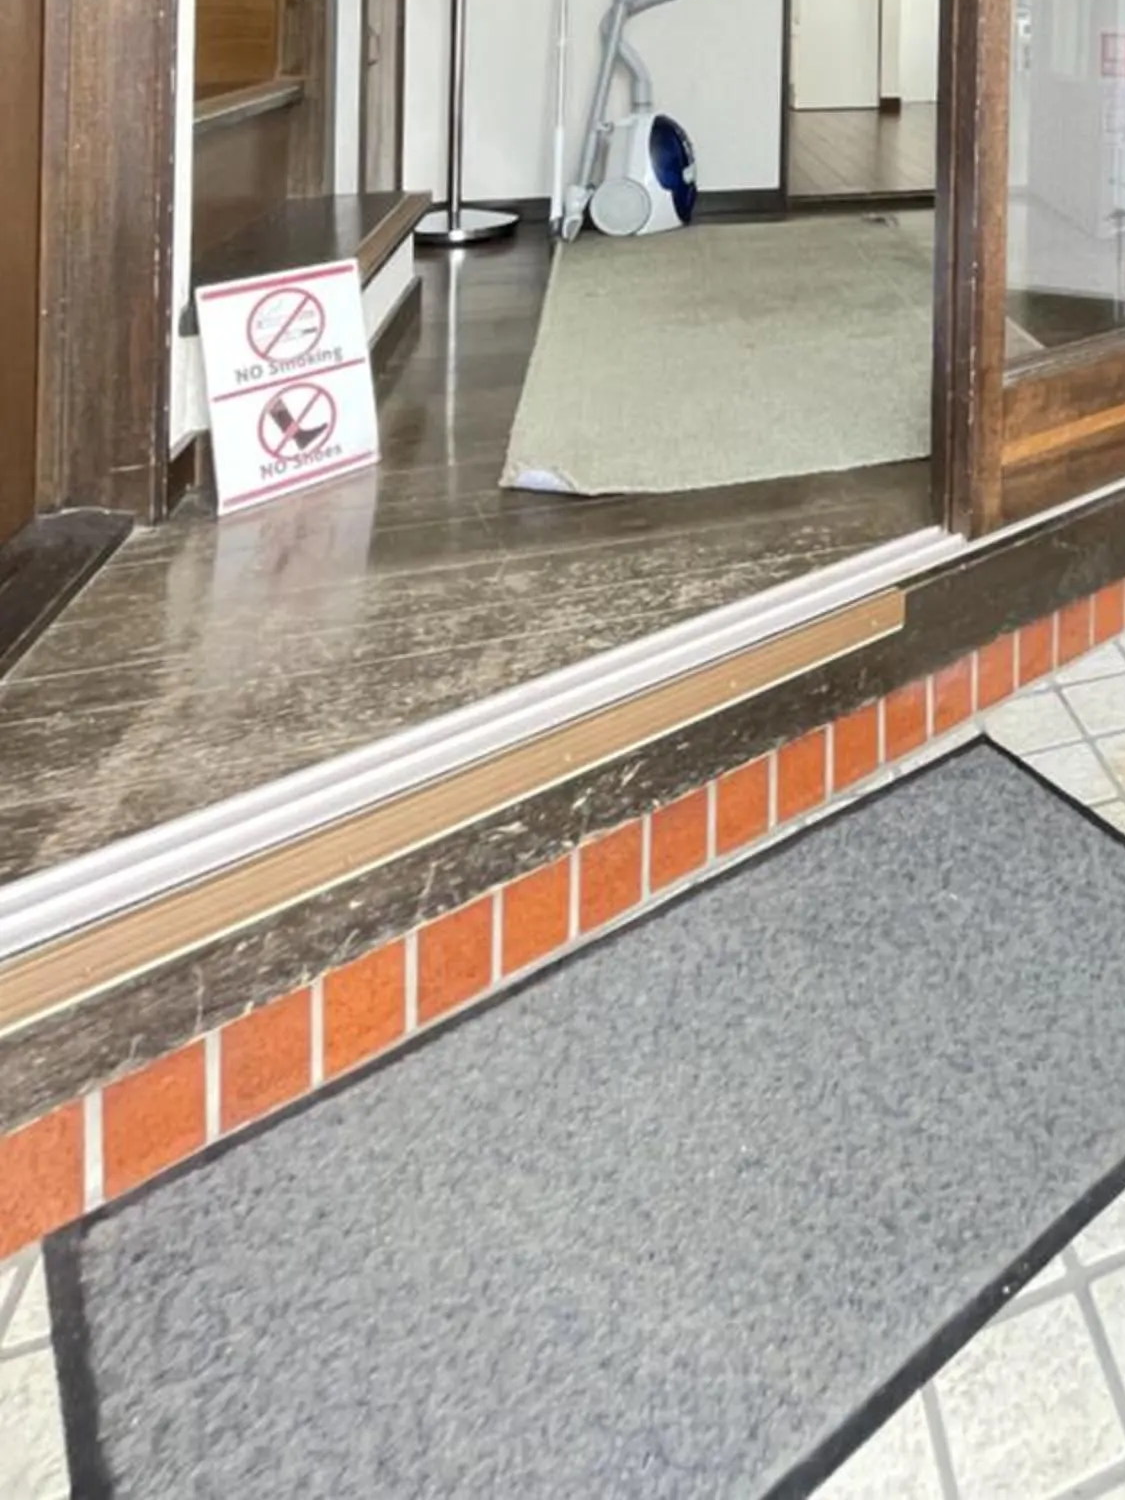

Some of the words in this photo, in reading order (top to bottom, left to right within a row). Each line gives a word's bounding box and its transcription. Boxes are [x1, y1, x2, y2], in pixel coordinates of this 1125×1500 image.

[234, 364, 263, 385] NO
[268, 346, 343, 376] Smoking
[259, 460, 288, 480] NO
